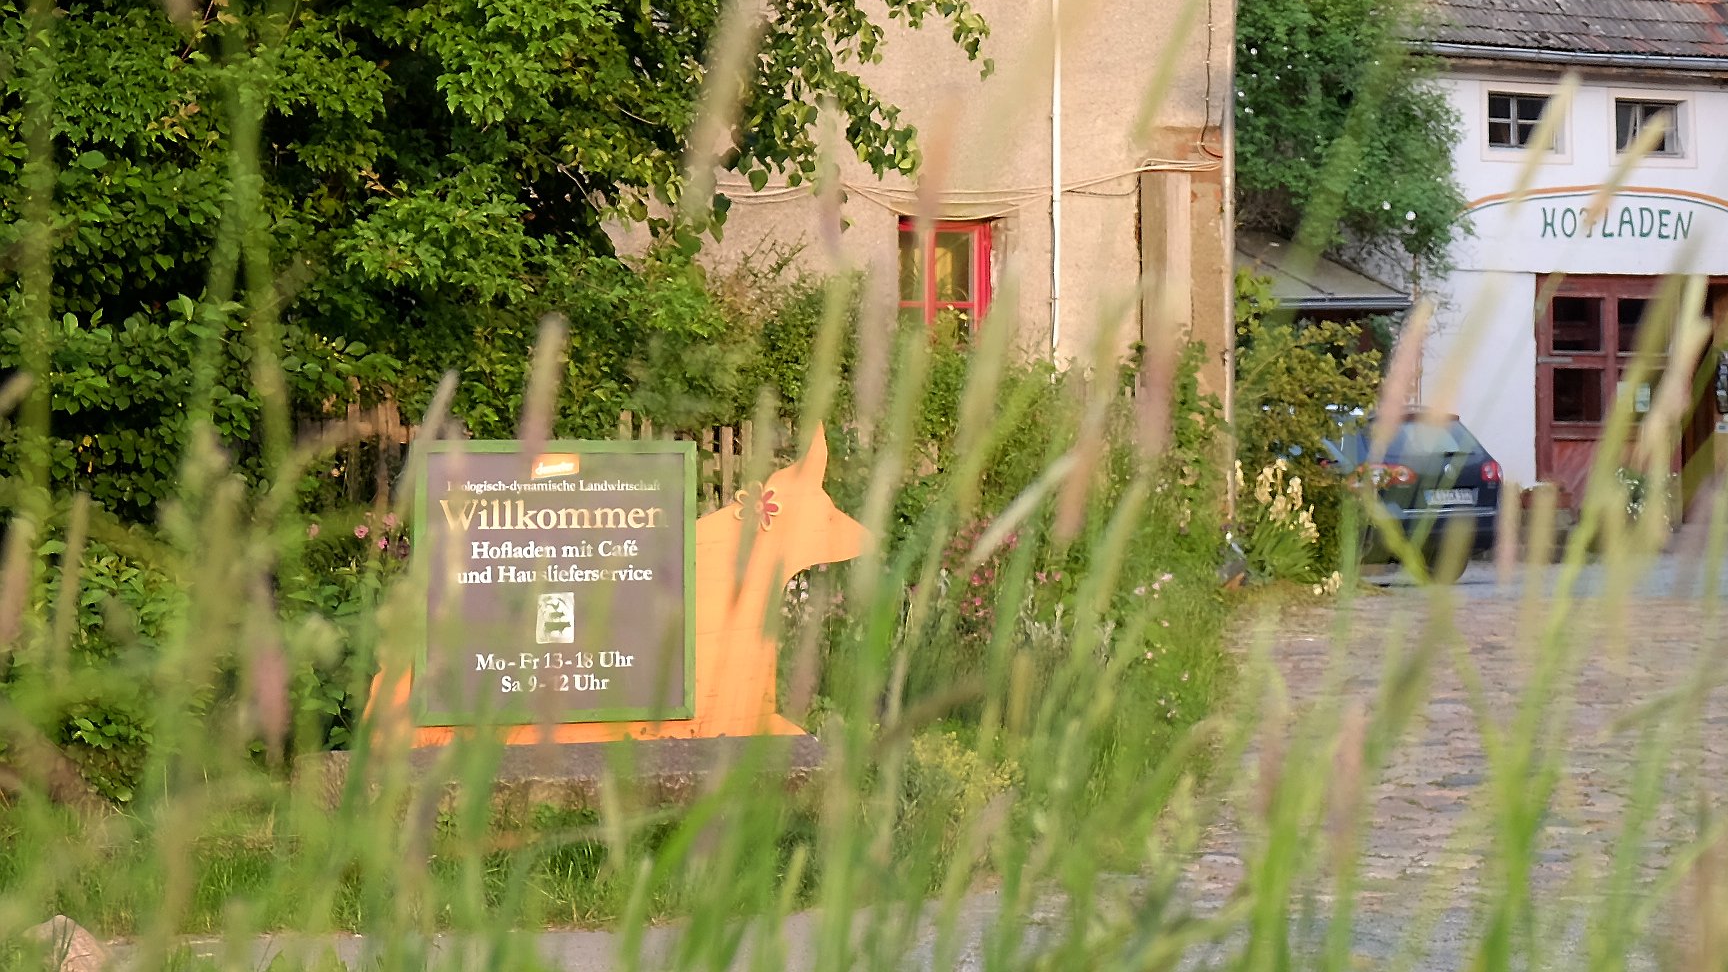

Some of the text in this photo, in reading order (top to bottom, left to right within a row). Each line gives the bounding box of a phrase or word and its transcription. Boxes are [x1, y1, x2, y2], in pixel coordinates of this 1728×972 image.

[471, 540, 638, 559] Hofladen mit Café
[457, 566, 492, 584] und
[598, 651, 634, 668] Uhr
[501, 676, 521, 693] Sa
[573, 673, 610, 691] Uhr
